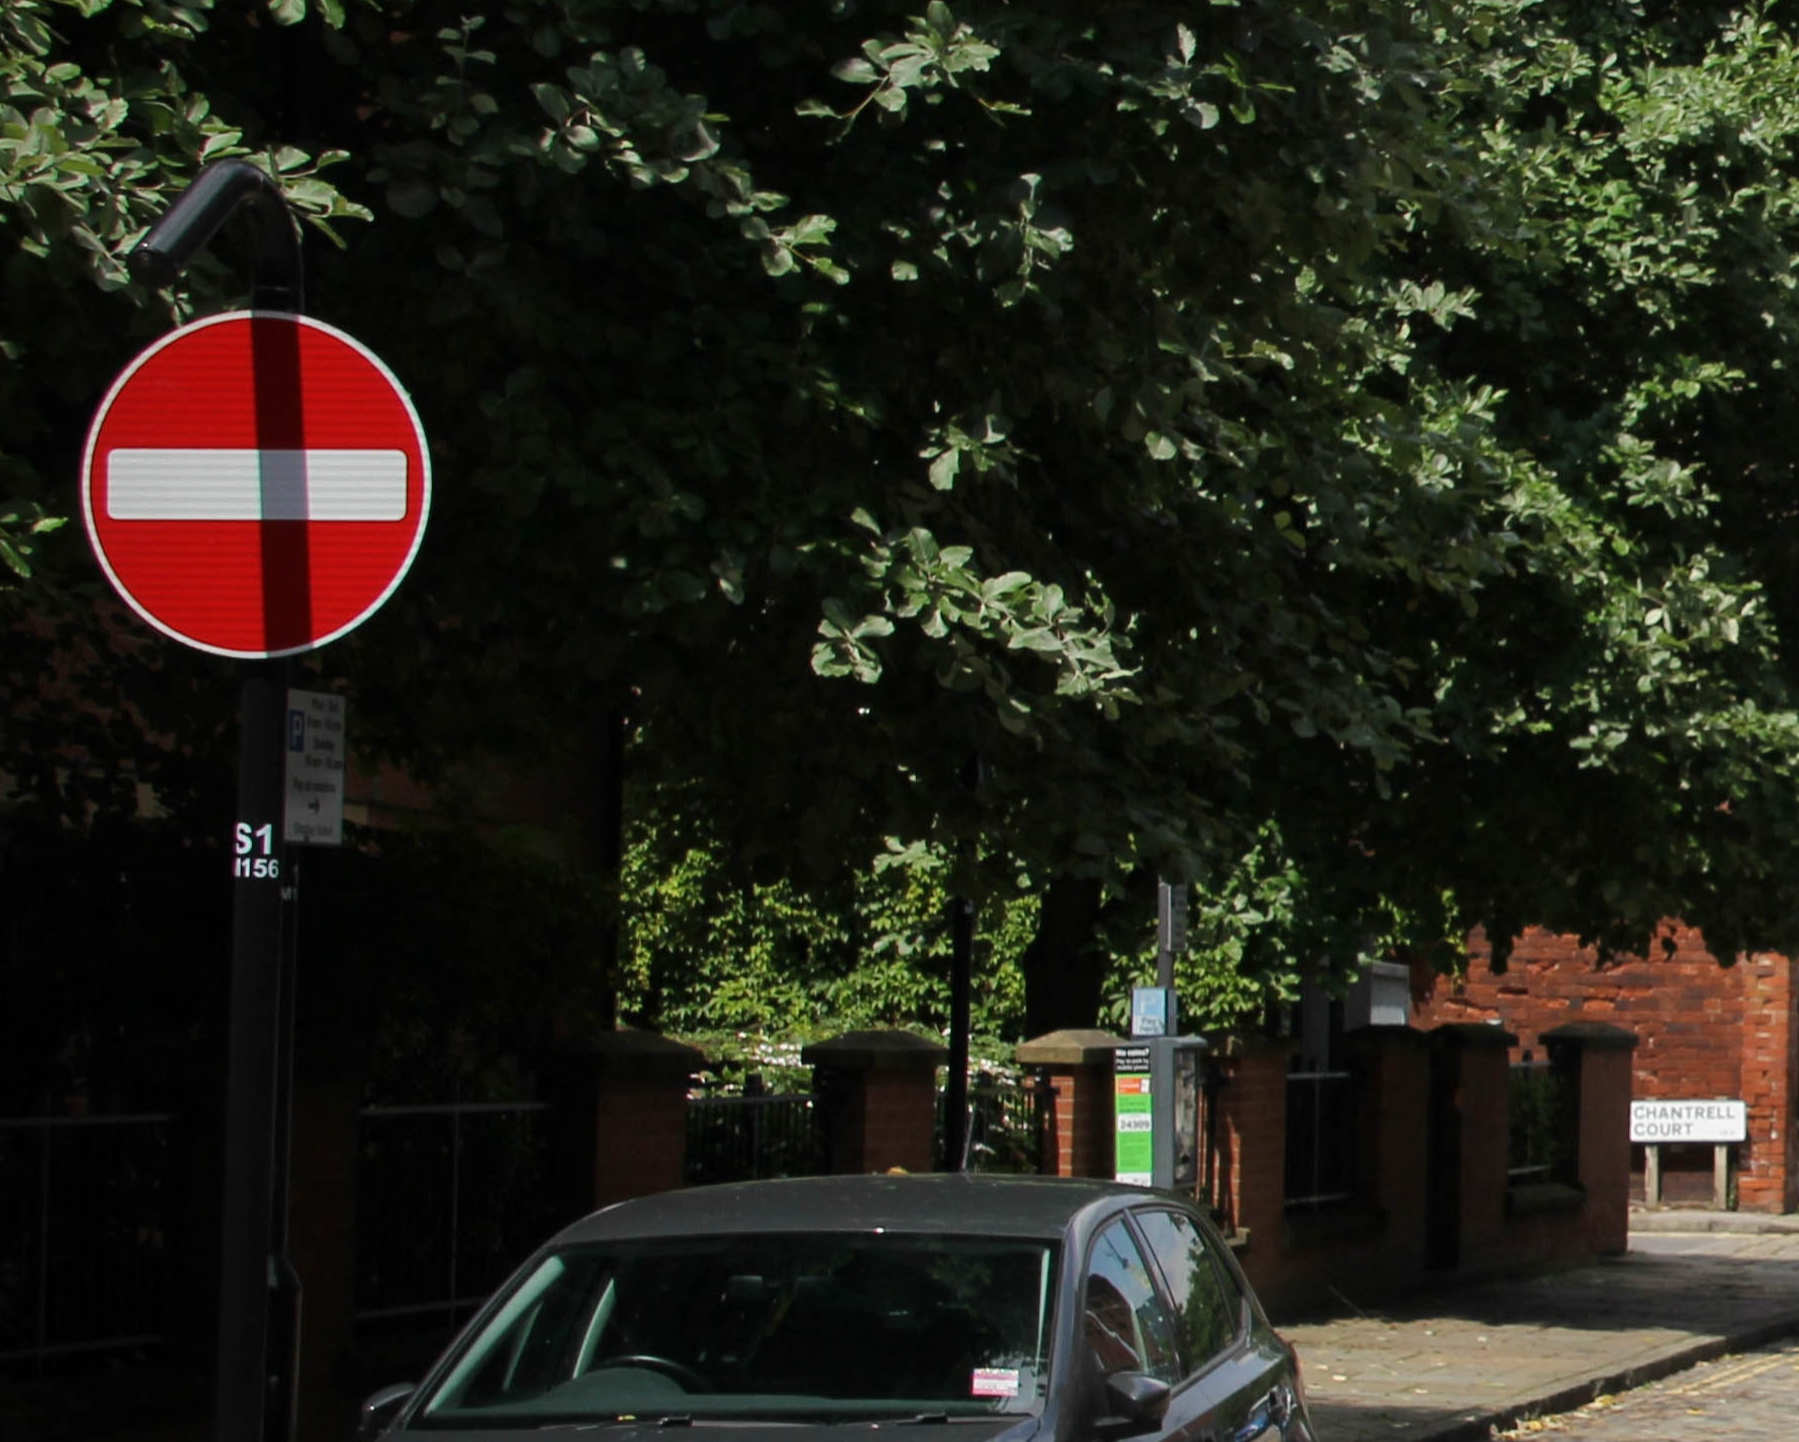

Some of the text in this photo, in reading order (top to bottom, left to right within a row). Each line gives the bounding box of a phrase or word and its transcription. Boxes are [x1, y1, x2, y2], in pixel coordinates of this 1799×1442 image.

[234, 822, 273, 856] S1
[1633, 1105, 1735, 1120] CHANTRELL
[1633, 1122, 1694, 1137] COURT
